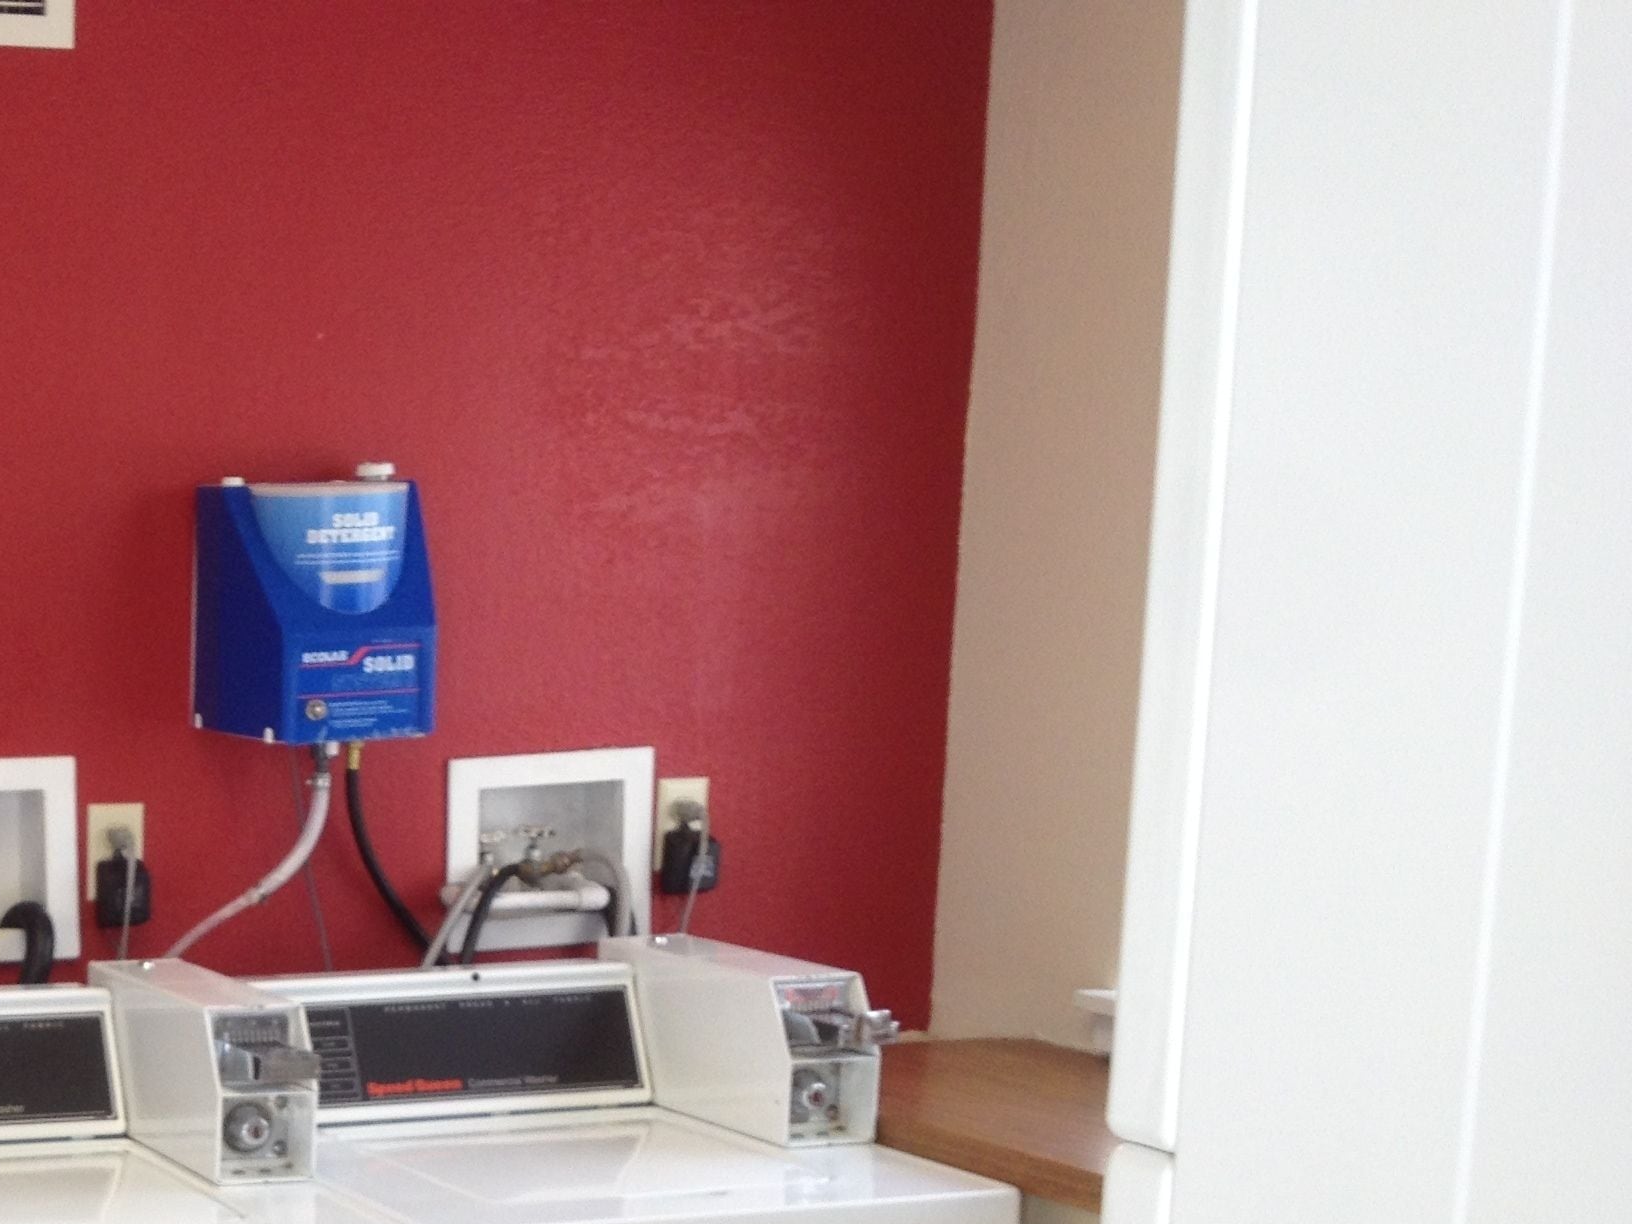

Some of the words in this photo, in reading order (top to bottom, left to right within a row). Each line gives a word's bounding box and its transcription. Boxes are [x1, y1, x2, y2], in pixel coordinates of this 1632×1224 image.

[331, 511, 379, 528] SOLID
[306, 526, 396, 544] DETERGENT
[362, 653, 416, 673] SOLID
